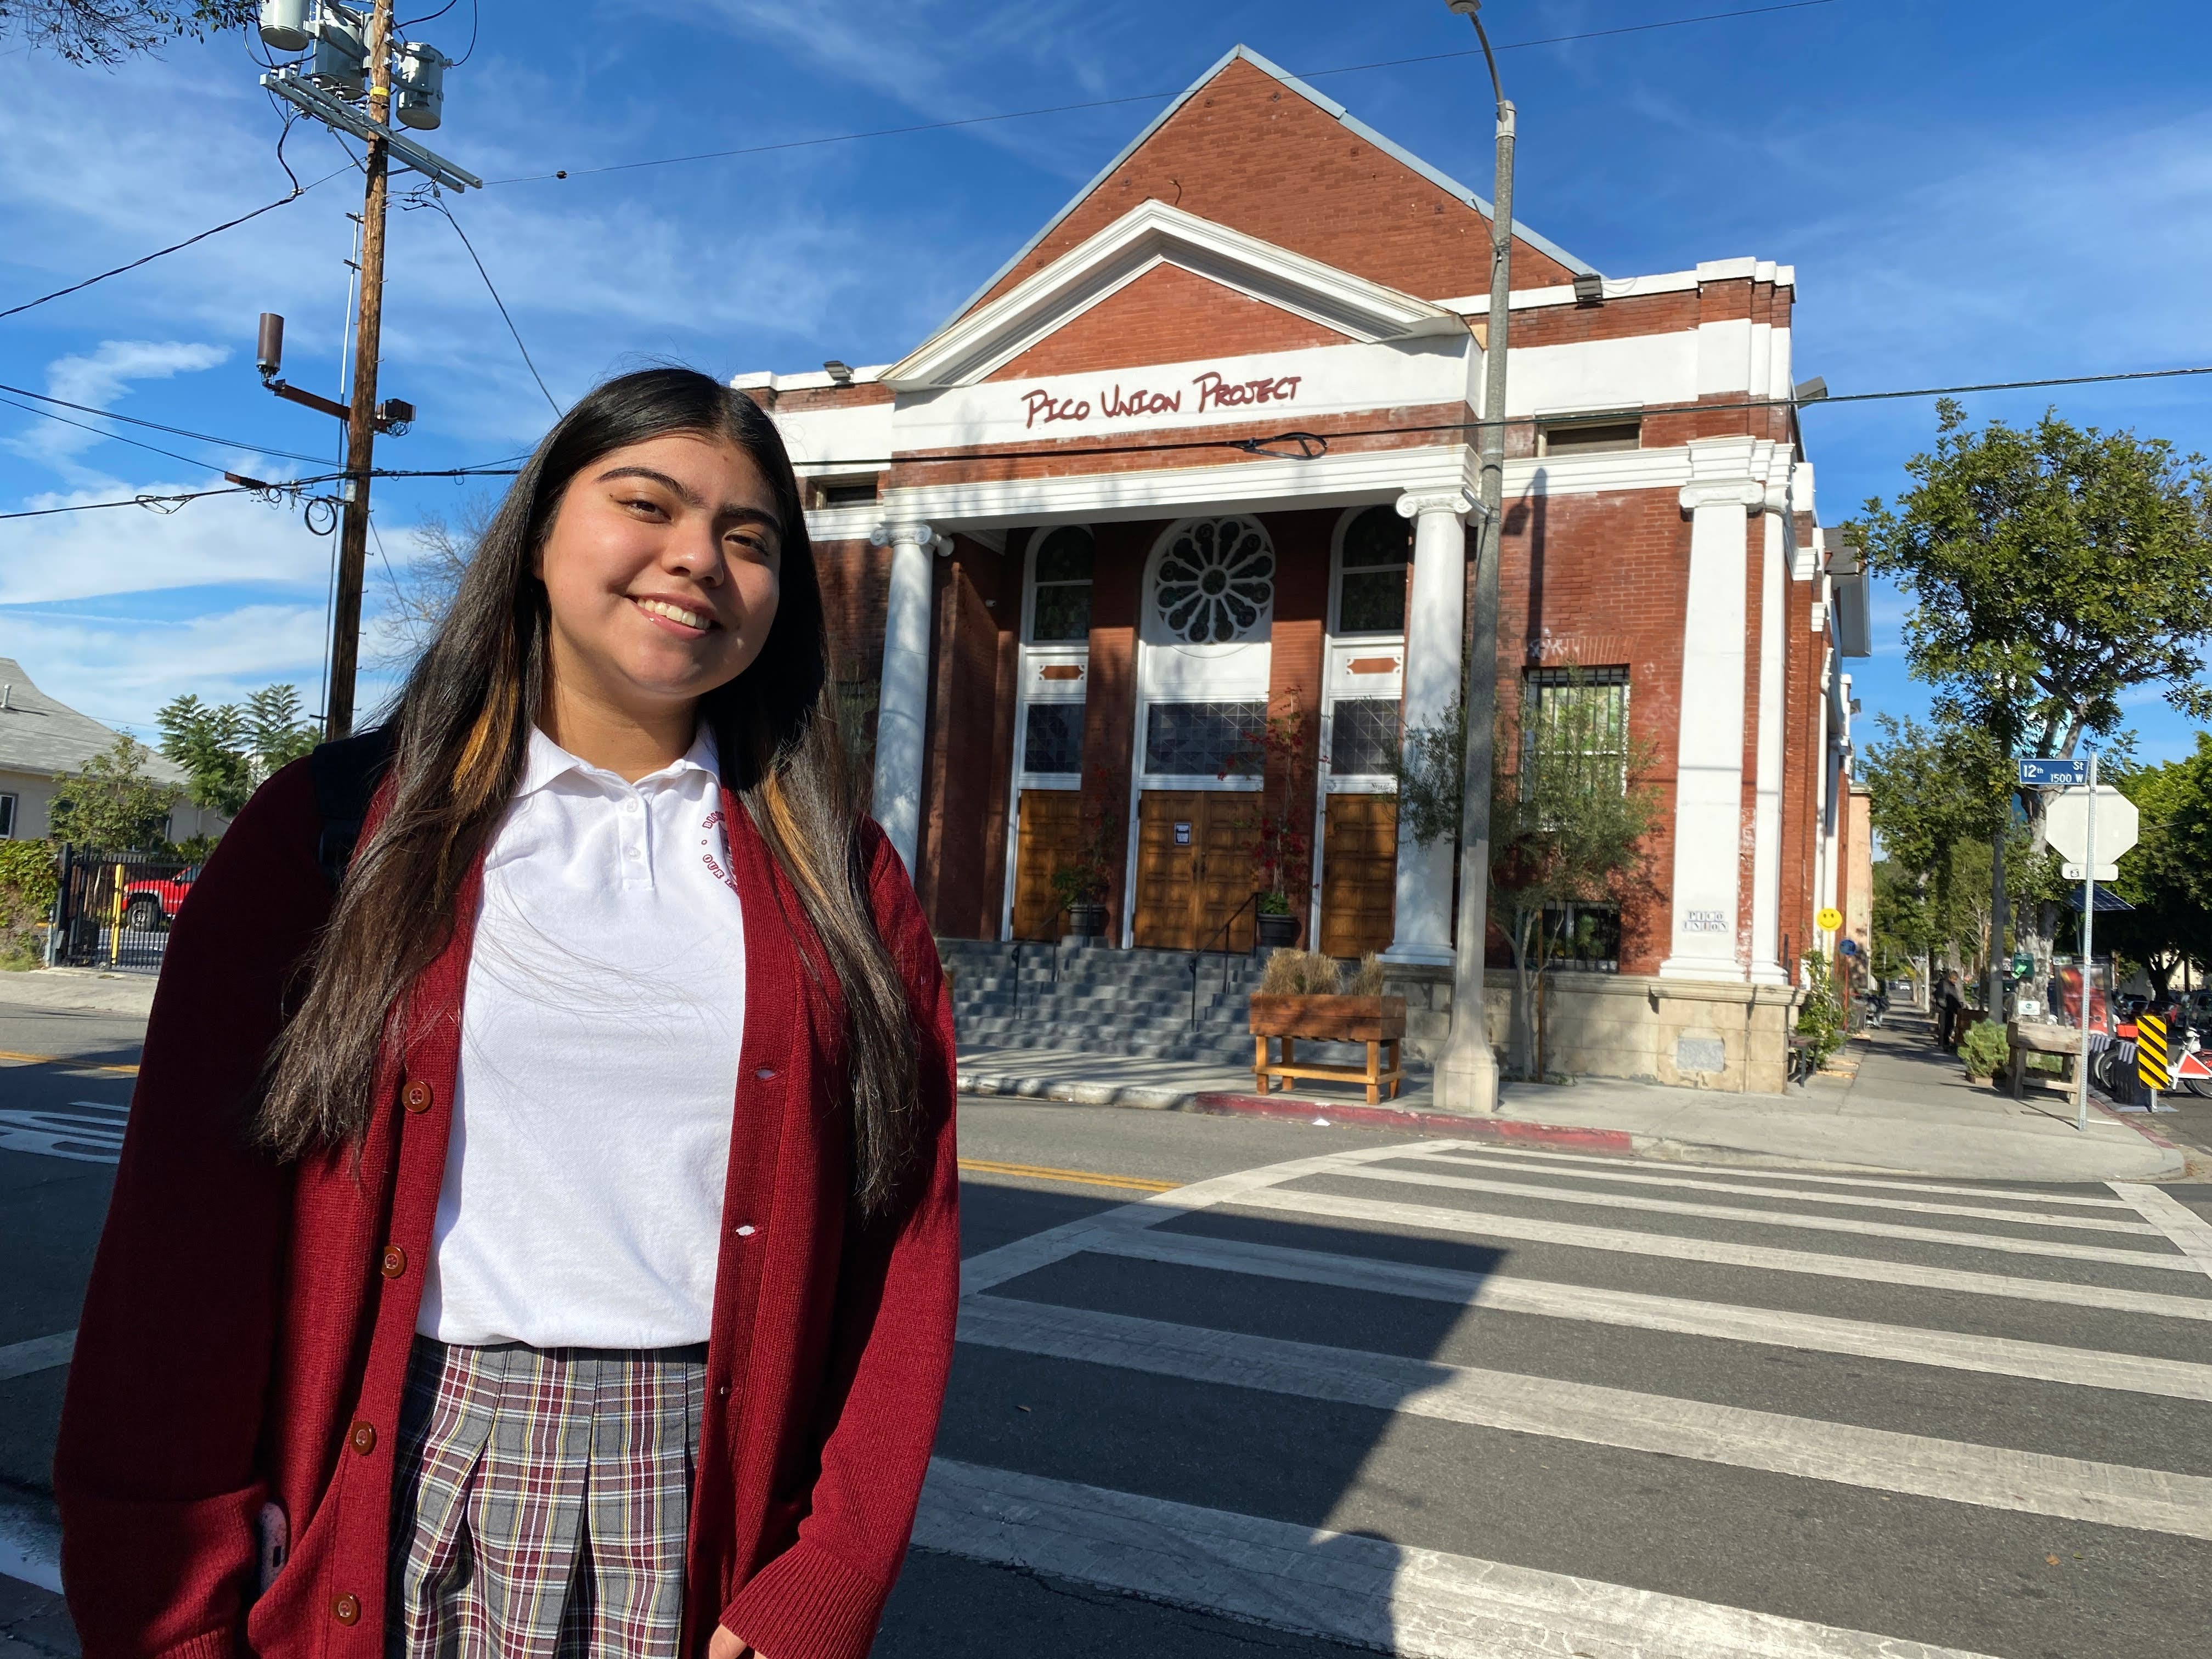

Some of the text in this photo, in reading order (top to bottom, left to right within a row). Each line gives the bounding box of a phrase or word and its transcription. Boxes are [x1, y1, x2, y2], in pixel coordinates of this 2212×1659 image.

[1020, 371, 1302, 429] PICO UNION PROJECT
[2023, 761, 2084, 778] 12th St
[2050, 774, 2084, 783] 1500 W
[703, 854, 725, 879] OUR
[1689, 911, 1723, 920] PICO
[1683, 922, 1727, 930] UNION
